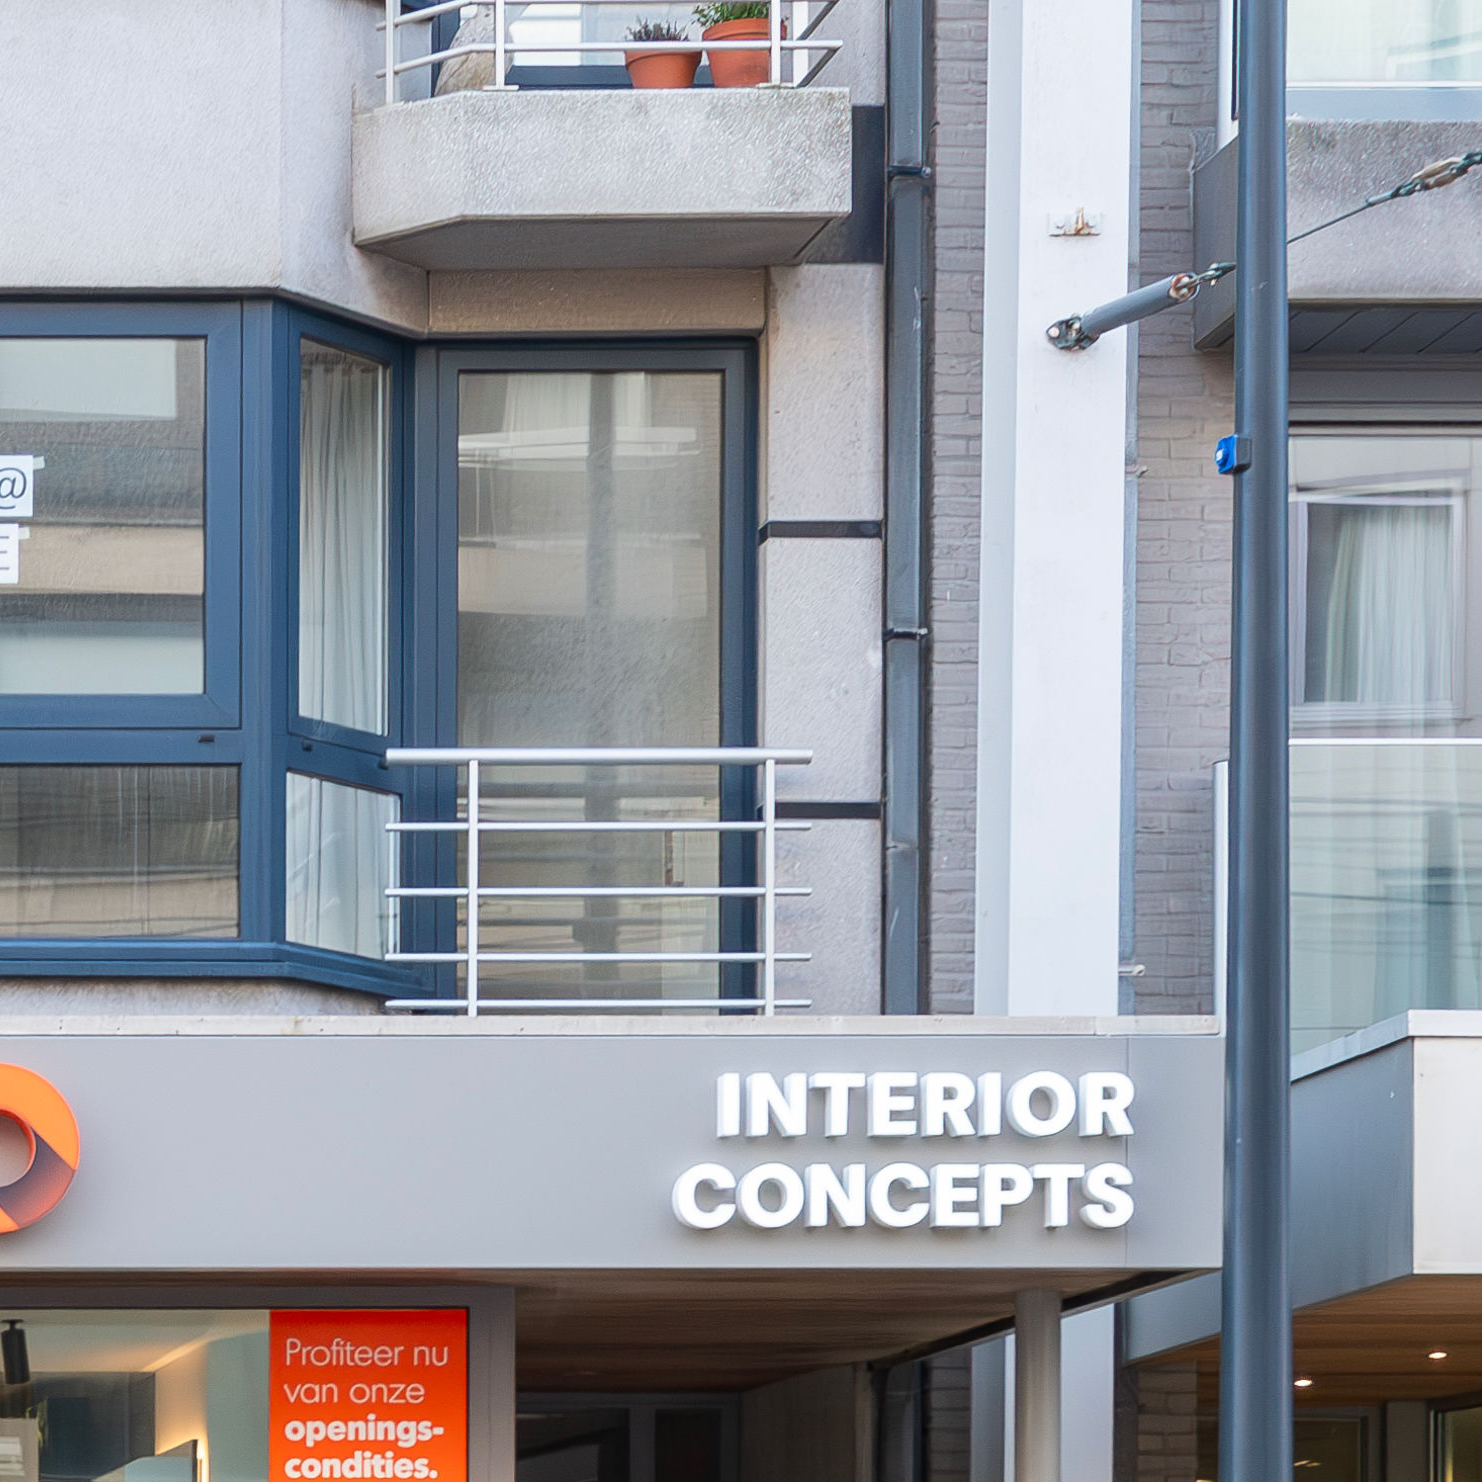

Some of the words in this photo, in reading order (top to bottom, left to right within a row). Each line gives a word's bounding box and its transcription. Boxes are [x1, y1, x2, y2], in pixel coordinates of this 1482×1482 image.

[717, 1070, 1135, 1138] INTERIOR
[672, 1162, 1135, 1230] CONCEPTS
[286, 1338, 404, 1367] Profiteer
[413, 1346, 448, 1367] nu
[283, 1383, 338, 1404] van
[349, 1383, 425, 1404] onze
[284, 1413, 444, 1448] openings-
[284, 1450, 438, 1479] condities.
